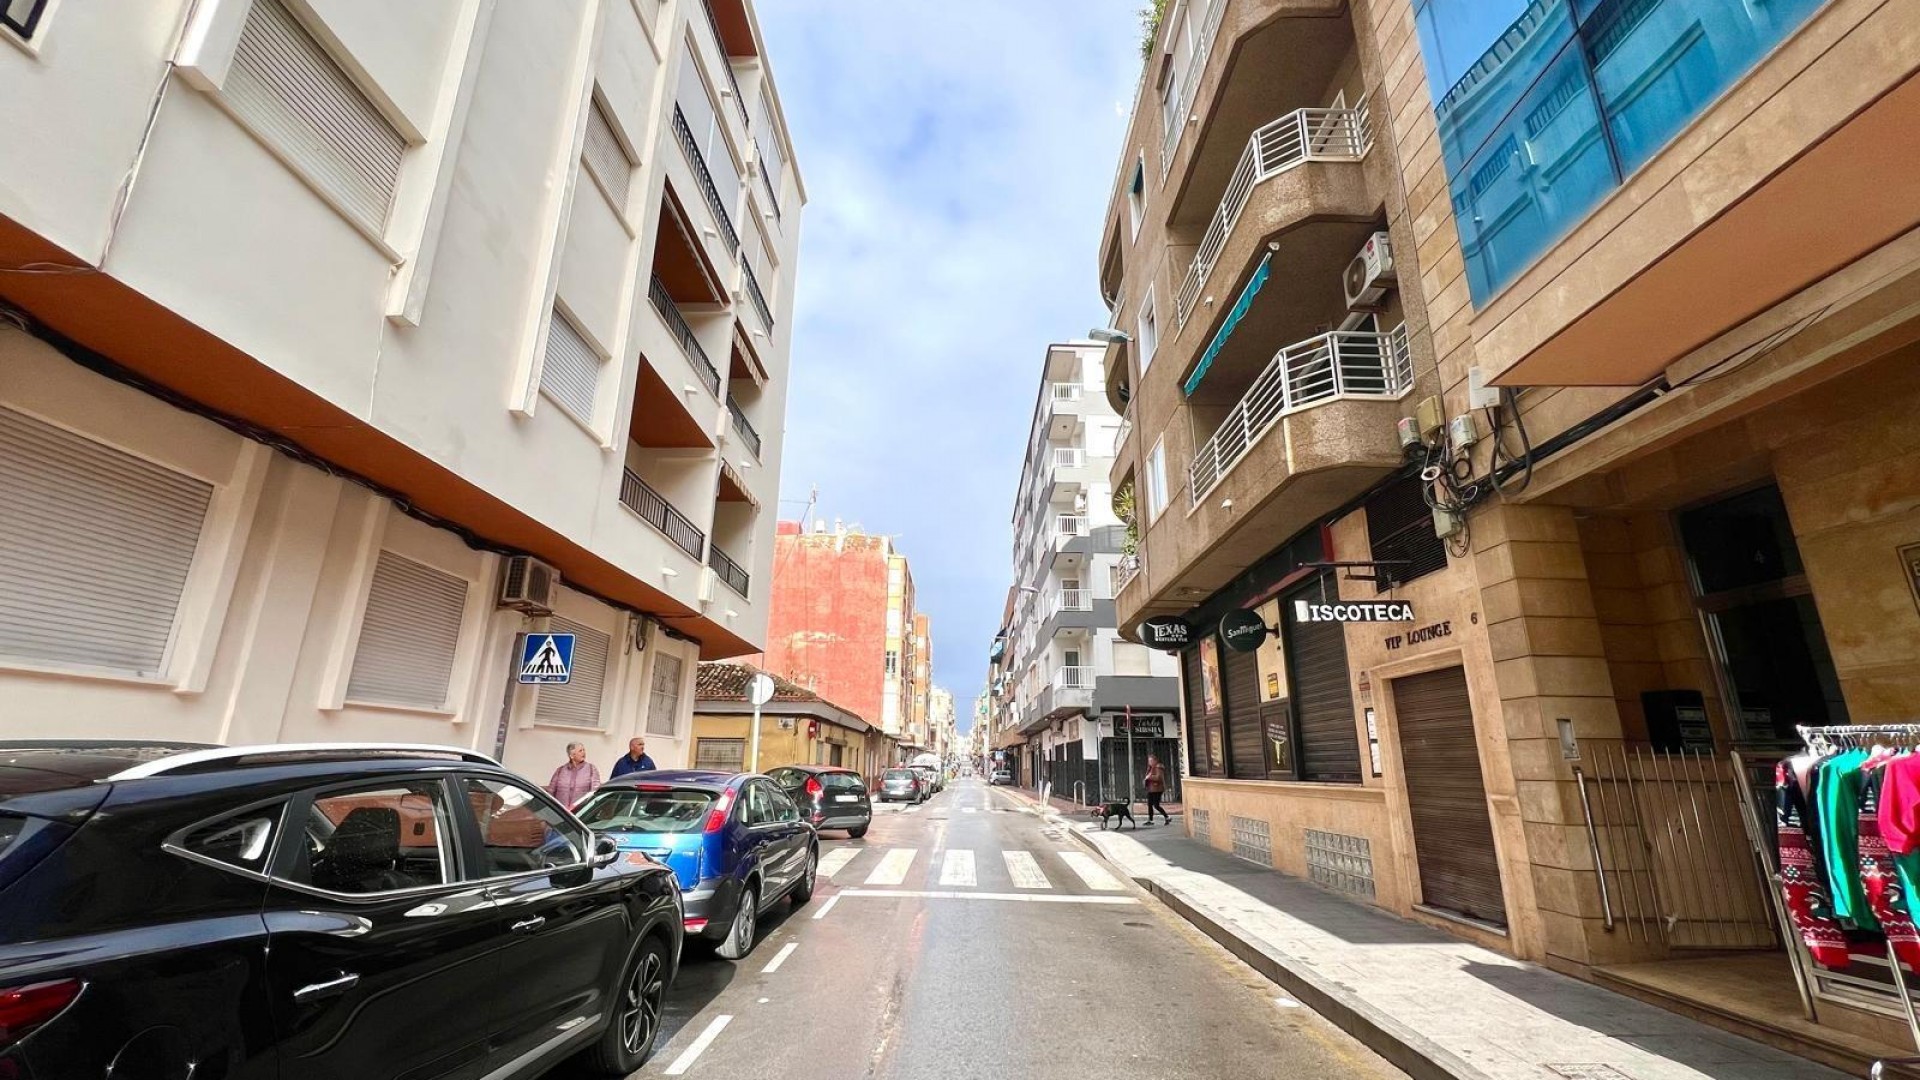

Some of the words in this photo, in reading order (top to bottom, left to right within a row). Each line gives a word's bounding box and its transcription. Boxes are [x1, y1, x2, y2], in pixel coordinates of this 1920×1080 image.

[1470, 612, 1478, 625] 6
[1146, 622, 1188, 636] TEXAS
[1385, 634, 1402, 650] VIP
[1407, 621, 1452, 644] LOUNGE
